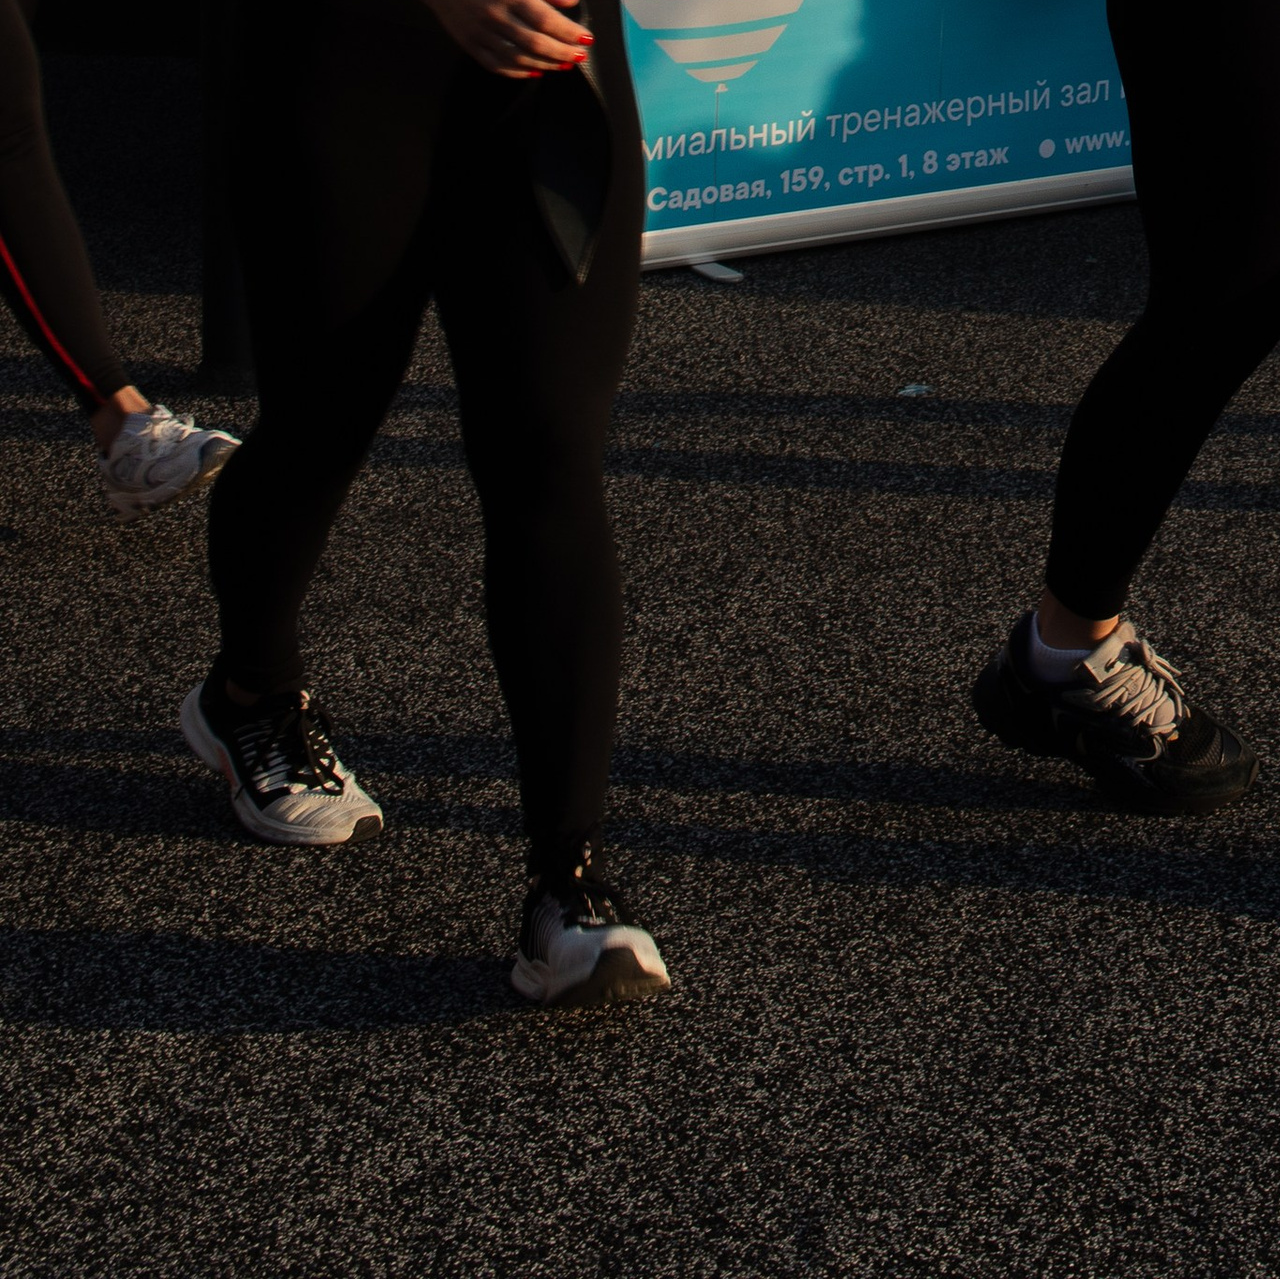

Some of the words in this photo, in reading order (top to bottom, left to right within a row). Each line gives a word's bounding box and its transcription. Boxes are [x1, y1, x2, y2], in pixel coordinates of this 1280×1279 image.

[826, 80, 1049, 142] тренажерный
[1059, 80, 1109, 108] зал
[1064, 130, 1131, 155] www.
[647, 178, 772, 211] Садовая,
[780, 165, 831, 192] 159,
[837, 163, 891, 188] стр.
[898, 153, 915, 180] 1,
[922, 149, 939, 175] 8
[946, 146, 1009, 171] этаж
